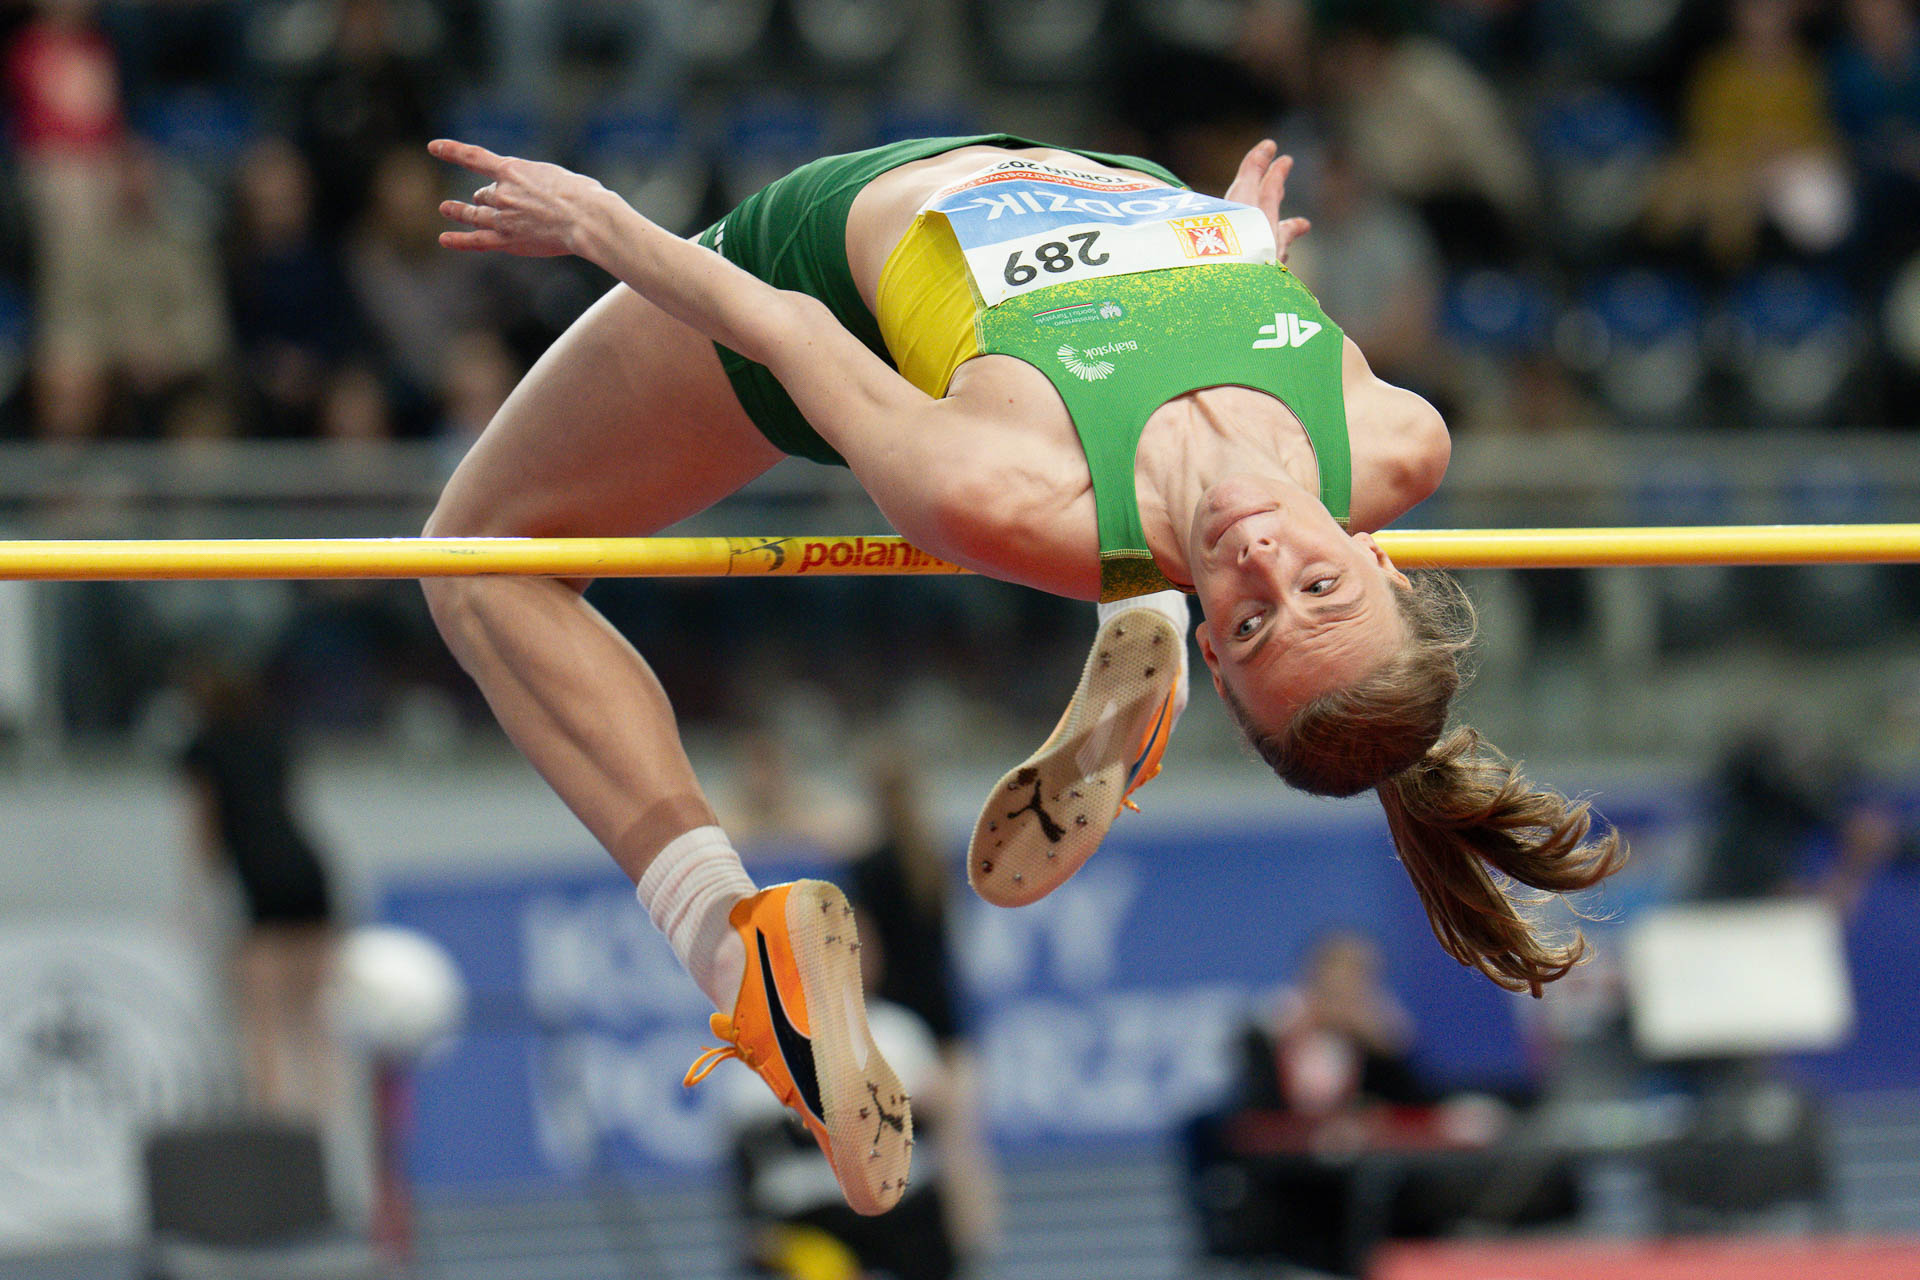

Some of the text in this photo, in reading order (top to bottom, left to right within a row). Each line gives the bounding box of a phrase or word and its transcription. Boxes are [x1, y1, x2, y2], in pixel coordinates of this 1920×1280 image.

[978, 172, 1072, 184] Mistrzostwa
[968, 191, 1210, 220] ŻODZIK
[1003, 230, 1110, 287] 289
[1035, 312, 1069, 325] Turystyki
[1054, 315, 1100, 326] Ministerstwo
[1073, 308, 1097, 317] Sportu
[1252, 312, 1322, 349] 4F
[1082, 340, 1138, 359] Białystok
